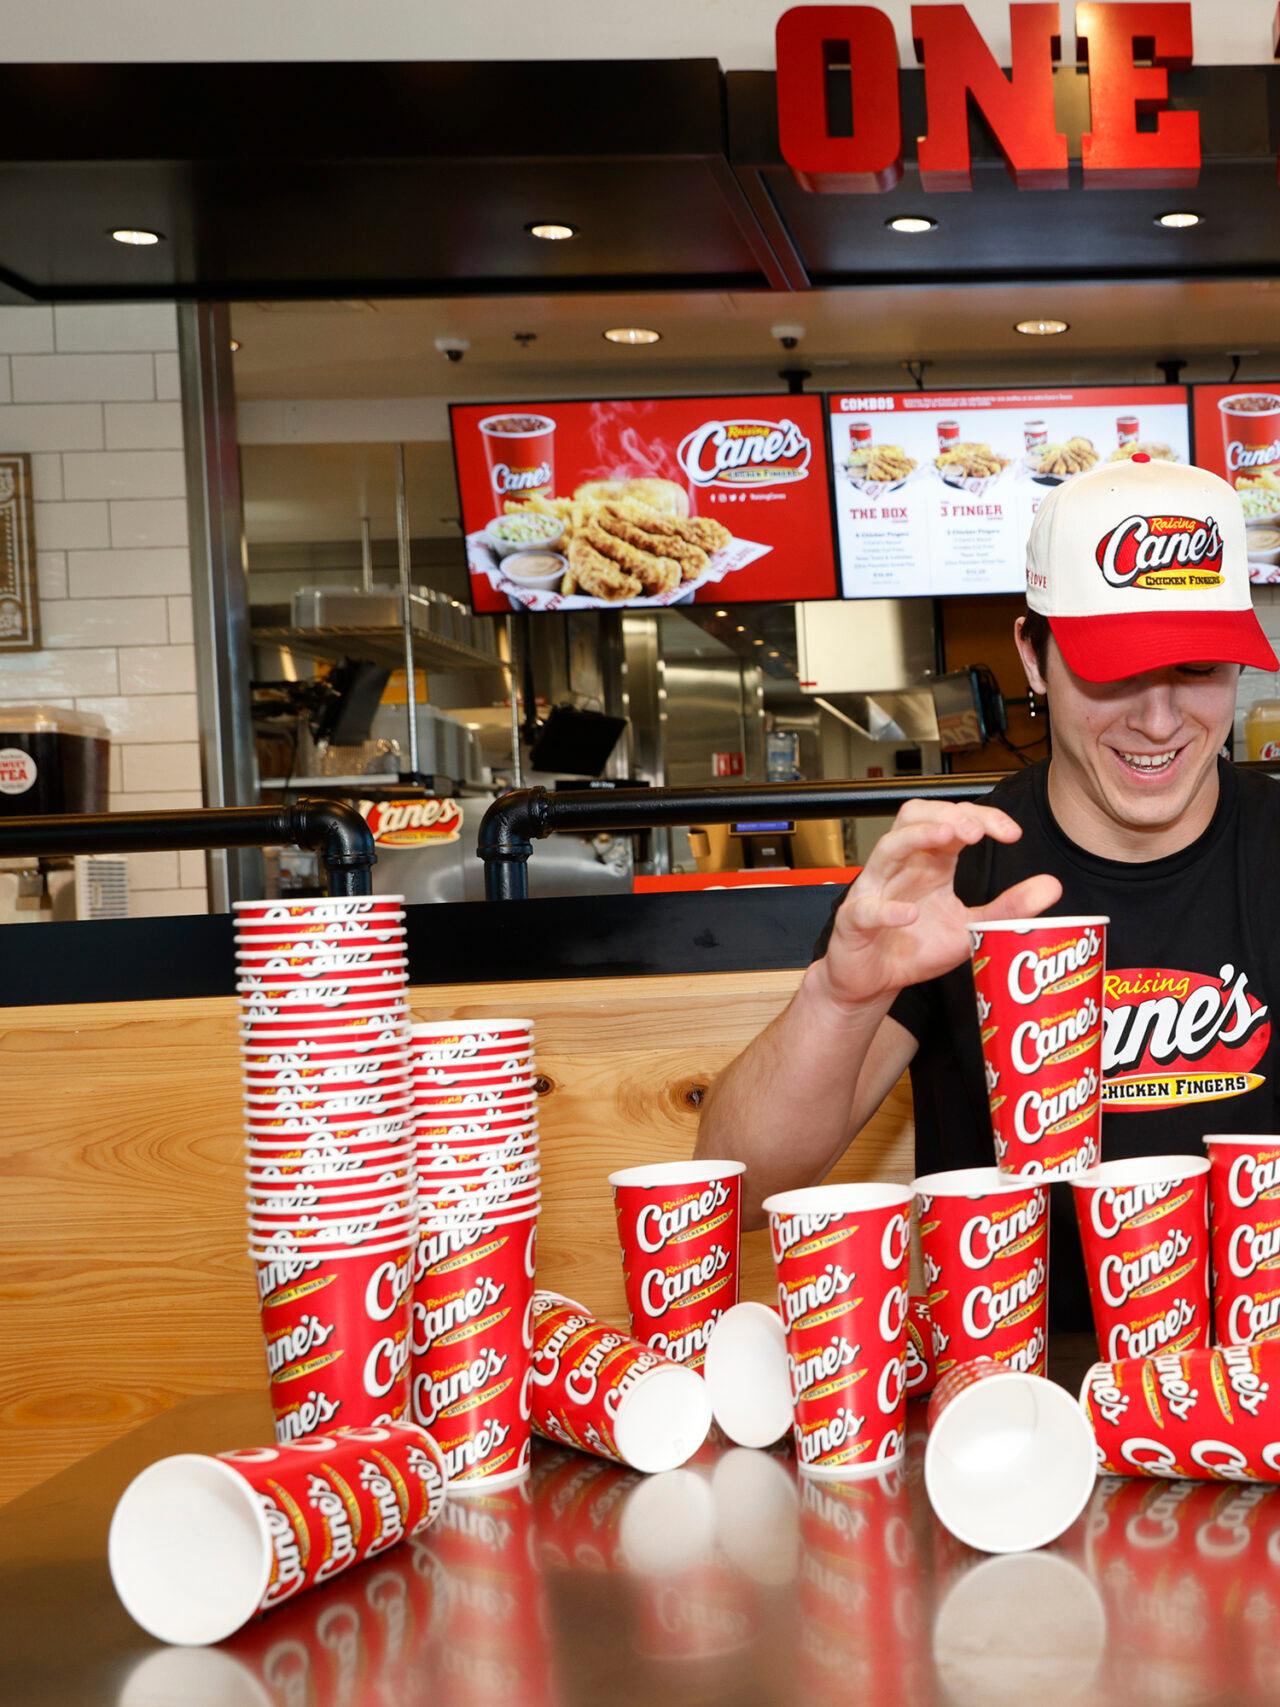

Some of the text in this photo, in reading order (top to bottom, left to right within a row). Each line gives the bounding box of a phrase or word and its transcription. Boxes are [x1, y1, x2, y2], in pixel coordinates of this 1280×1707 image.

[774, 2, 1201, 193] ONE
[840, 397, 895, 411] COMBOS
[687, 419, 806, 481] Cane's
[850, 507, 907, 520] THE BOX
[941, 505, 1002, 517] 3 FINGER
[1151, 518, 1196, 532] Raising
[1102, 516, 1223, 584] Cane's
[1145, 576, 1187, 586] CHICKEN
[1008, 928, 1101, 1004] Cane's
[1105, 973, 1190, 999] Raising
[1012, 997, 1100, 1074] Cane's
[1103, 964, 1268, 1071] ane's
[1015, 1067, 1099, 1144] Cane's
[1175, 1076, 1246, 1095] FINGERS
[636, 1181, 730, 1253] Cane's
[662, 1192, 700, 1212] Raising
[960, 1189, 1046, 1269] Cane's
[641, 1245, 730, 1317] Cane's
[665, 1256, 701, 1276] Raising
[778, 1264, 855, 1334] Cane's
[963, 1258, 1045, 1339] Cane's
[1100, 1229, 1192, 1307] Cane's
[268, 1315, 334, 1373] ane's
[414, 1277, 504, 1355] Cane's
[1109, 1298, 1197, 1360] Cane's
[414, 1348, 507, 1427] Cane's
[565, 1333, 631, 1405] Cane's
[276, 1391, 340, 1443] ane's
[448, 1419, 510, 1480] ane's
